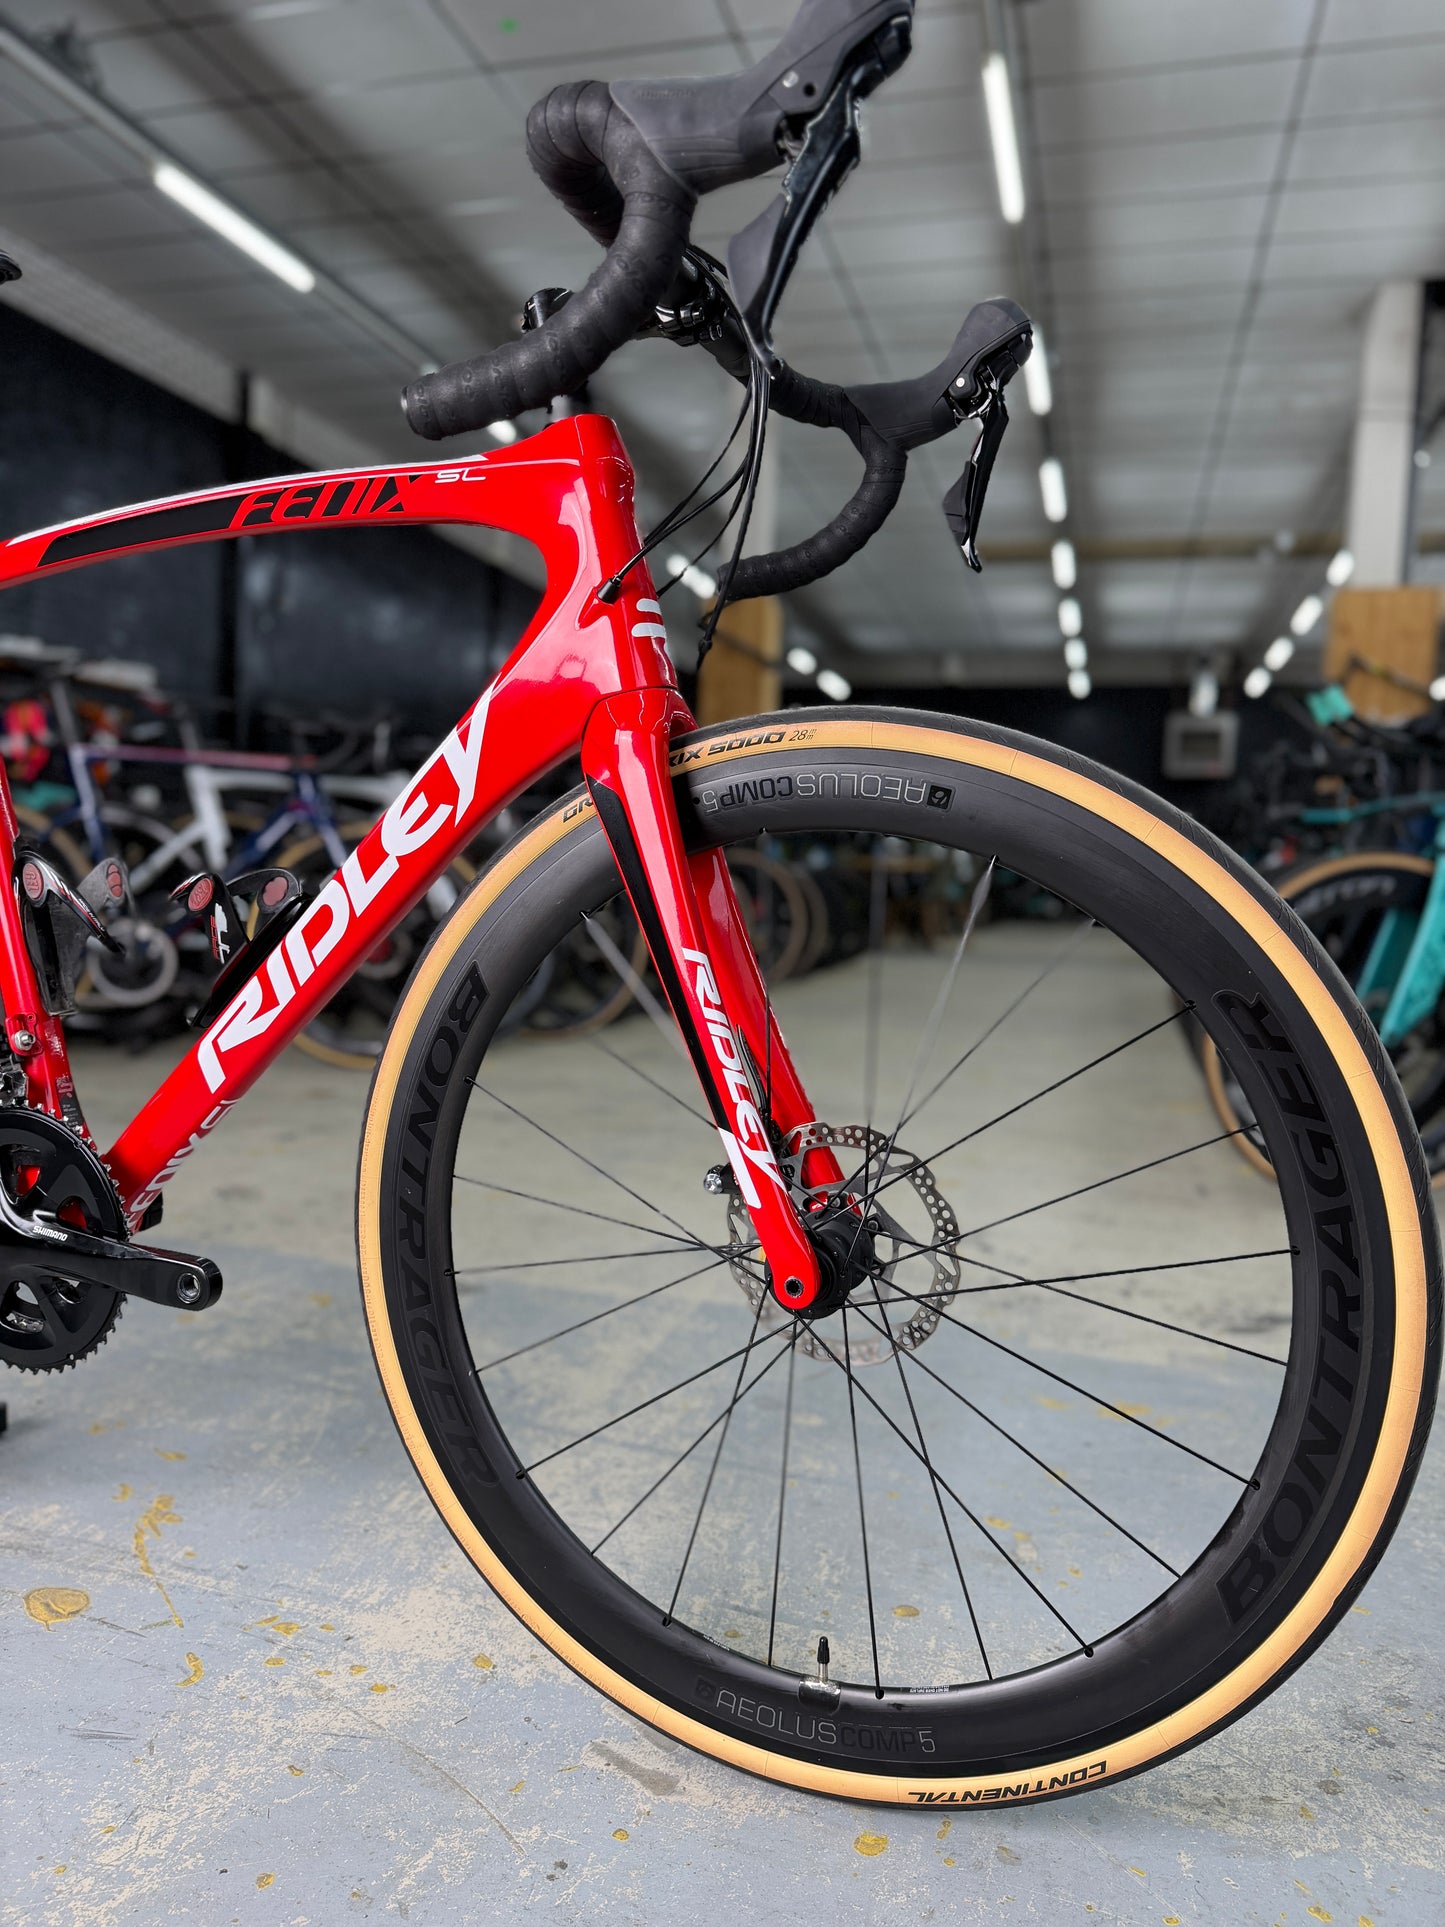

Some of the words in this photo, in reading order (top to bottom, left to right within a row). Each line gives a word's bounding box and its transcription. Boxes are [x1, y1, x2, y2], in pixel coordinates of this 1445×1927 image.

[228, 473, 425, 529] FENIX
[435, 468, 487, 484] SL
[708, 731, 787, 756] 5000
[197, 672, 502, 1094] RIDLEY
[682, 947, 788, 1195] RIDLEY
[33, 1225, 69, 1242] SHIMANO
[399, 961, 500, 1489] BONTRAGER
[1216, 992, 1361, 1626] BONTRAGER
[908, 1760, 1108, 1804] CONTINENTAL
